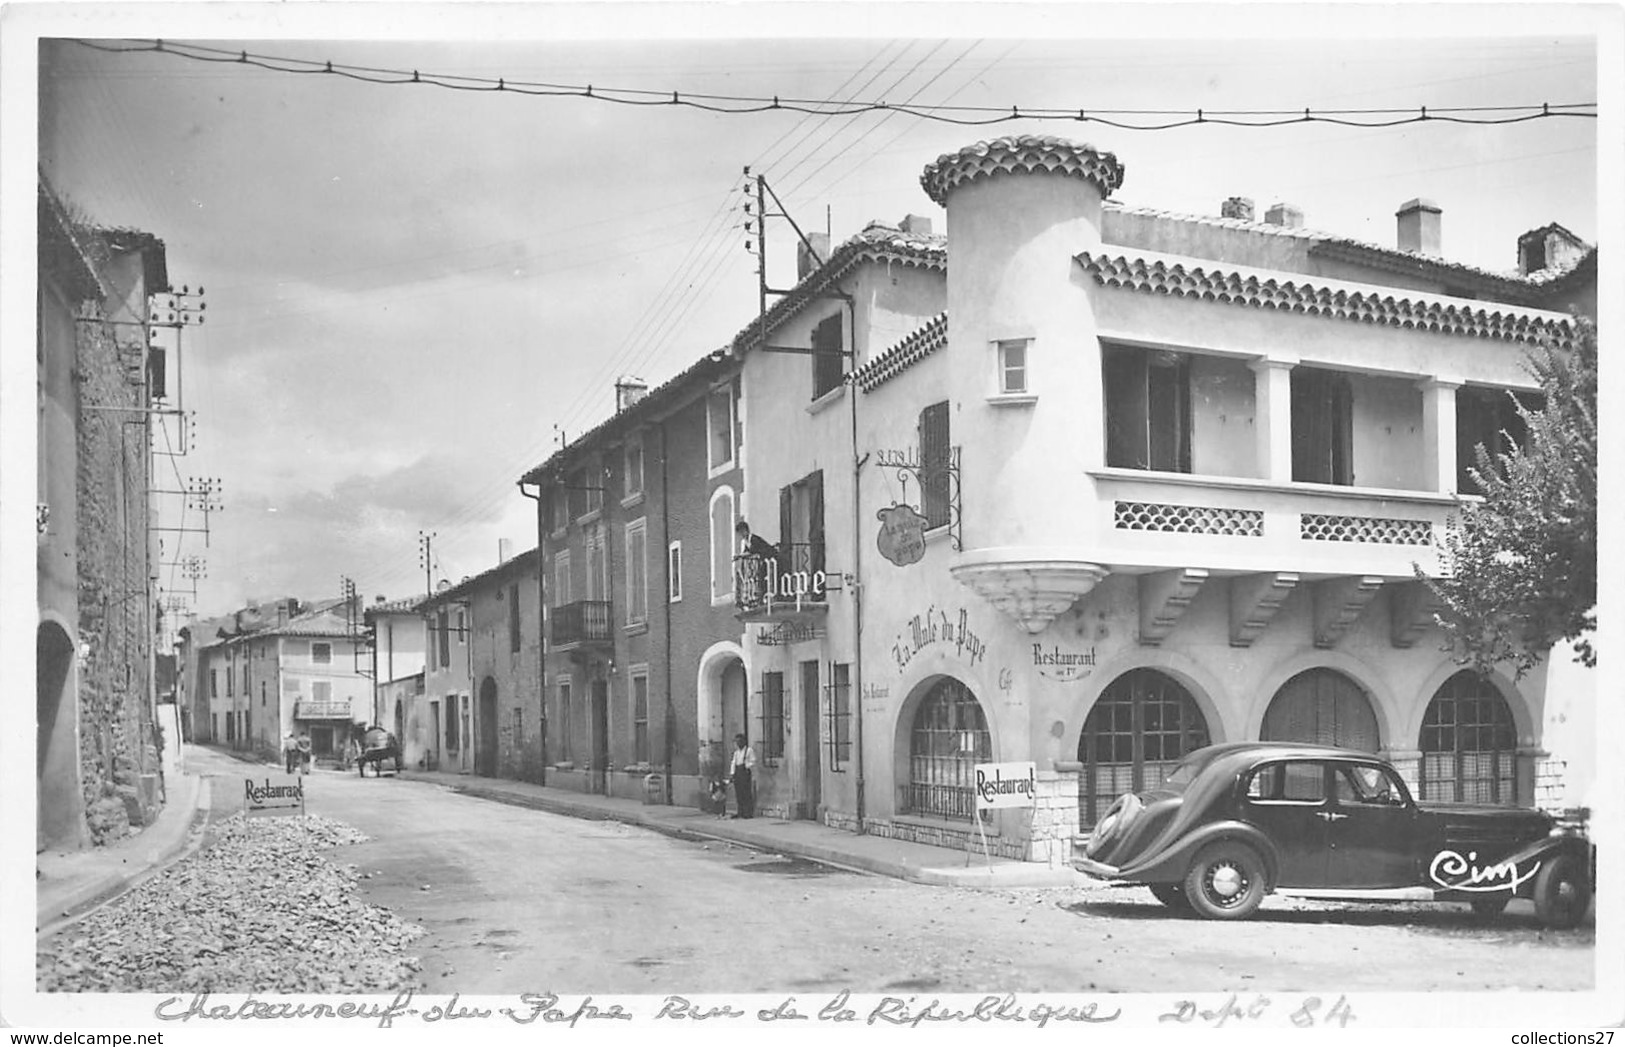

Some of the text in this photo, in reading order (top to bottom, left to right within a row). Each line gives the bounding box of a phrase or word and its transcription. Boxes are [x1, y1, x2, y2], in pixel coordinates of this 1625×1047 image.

[763, 557, 826, 616] Pape
[941, 610, 954, 642] du
[955, 607, 986, 668] Pape
[1032, 643, 1096, 666] Restaurant
[245, 776, 303, 804] Restaurant
[976, 767, 1035, 803] Restaurant
[655, 995, 745, 1021] Rue
[757, 996, 809, 1021] de
[818, 988, 861, 1022] la
[1289, 995, 1357, 1028] 84
